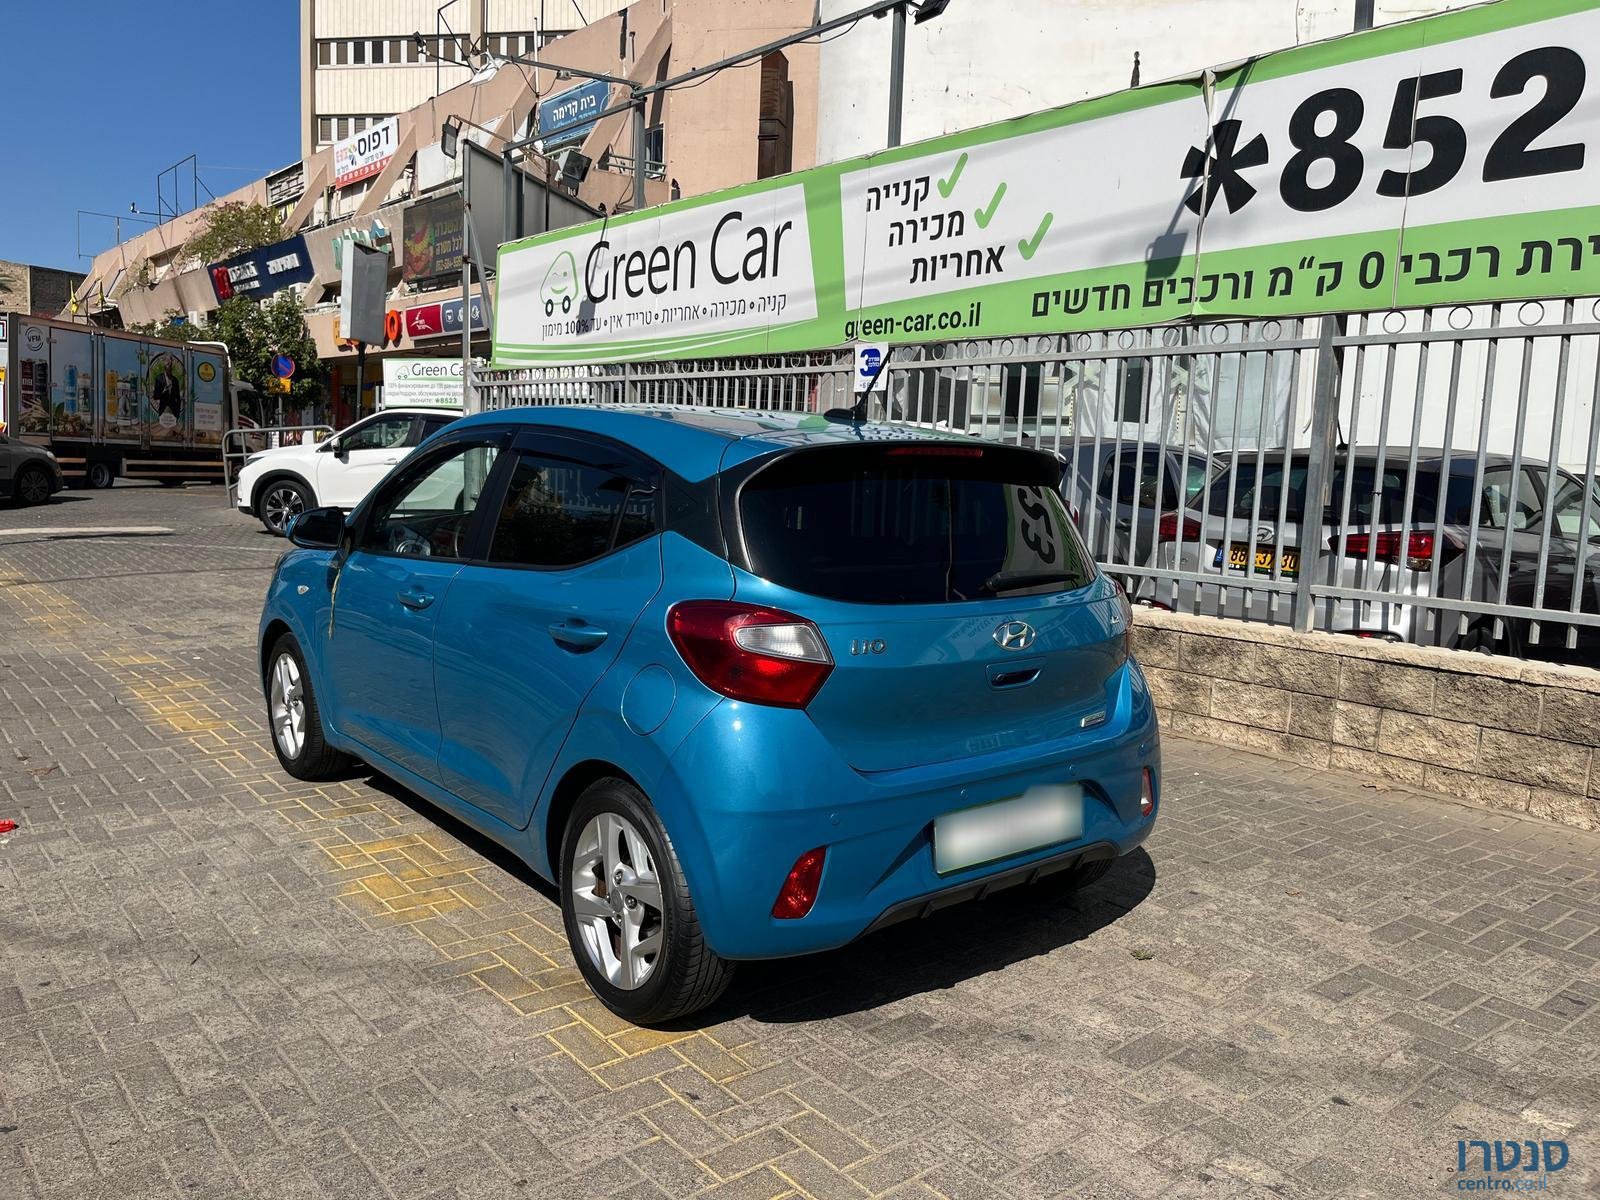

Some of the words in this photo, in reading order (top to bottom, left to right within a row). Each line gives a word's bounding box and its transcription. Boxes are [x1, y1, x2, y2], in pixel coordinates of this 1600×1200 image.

[553, 100, 578, 122] קדימה
[580, 95, 596, 111] בית
[358, 126, 390, 156] דפוס
[866, 176, 930, 212] קנייה
[888, 210, 964, 247] מכירה
[585, 240, 696, 304] Green
[710, 211, 792, 286] Car
[909, 245, 1006, 284] אחריות
[1358, 251, 1385, 290] 0
[1401, 244, 1500, 286] רכבי
[757, 293, 787, 313] קניה
[1031, 282, 1131, 318] חדשים
[1143, 270, 1253, 307] ורכבים
[609, 314, 623, 333] אין
[661, 305, 700, 323] אחריות
[710, 299, 746, 320] מכירה
[844, 301, 982, 342] green-car.co.il
[542, 322, 562, 341] מימון
[565, 320, 589, 335] 100%
[411, 363, 447, 377] Green
[450, 363, 464, 377] Ca
